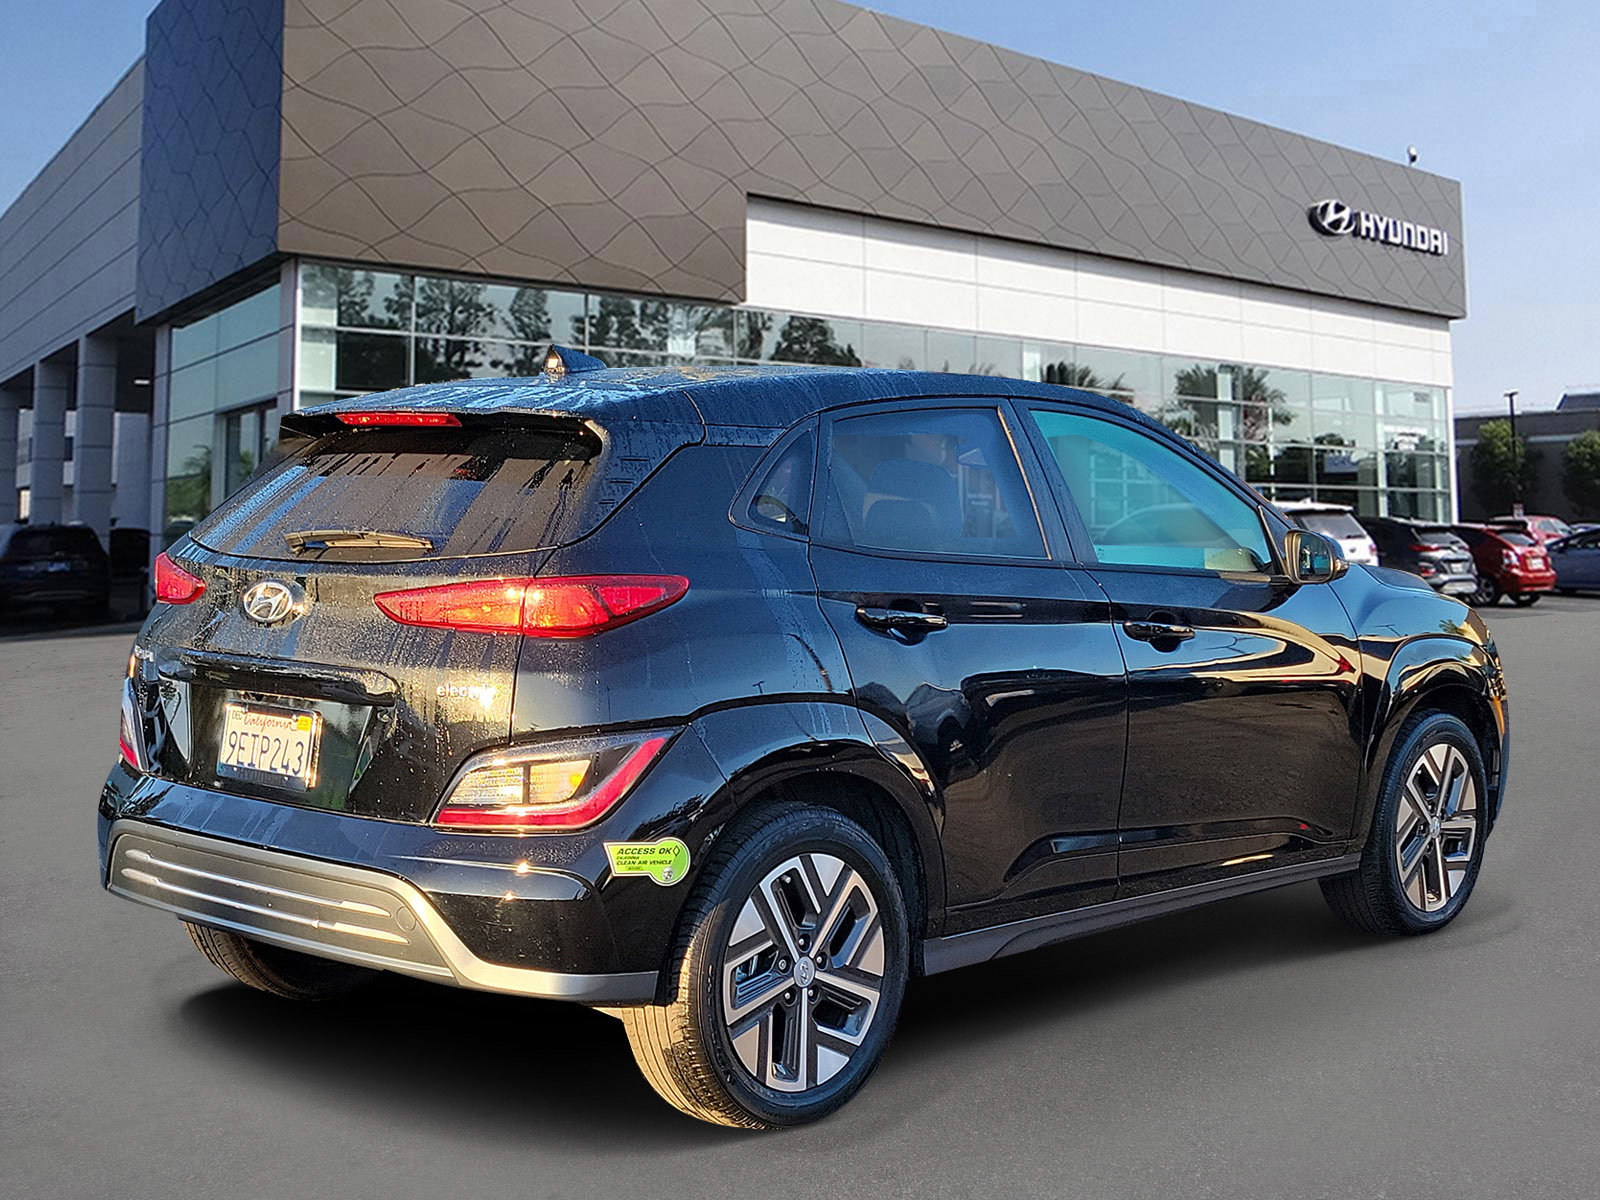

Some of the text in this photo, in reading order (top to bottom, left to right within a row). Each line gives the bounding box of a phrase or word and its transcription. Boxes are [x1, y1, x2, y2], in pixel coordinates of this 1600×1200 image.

[1360, 210, 1448, 256] HYUNDAI
[436, 682, 496, 701] elect
[243, 712, 297, 733] California
[225, 730, 305, 776] 9EIP243
[616, 847, 673, 855] ACCESS OK
